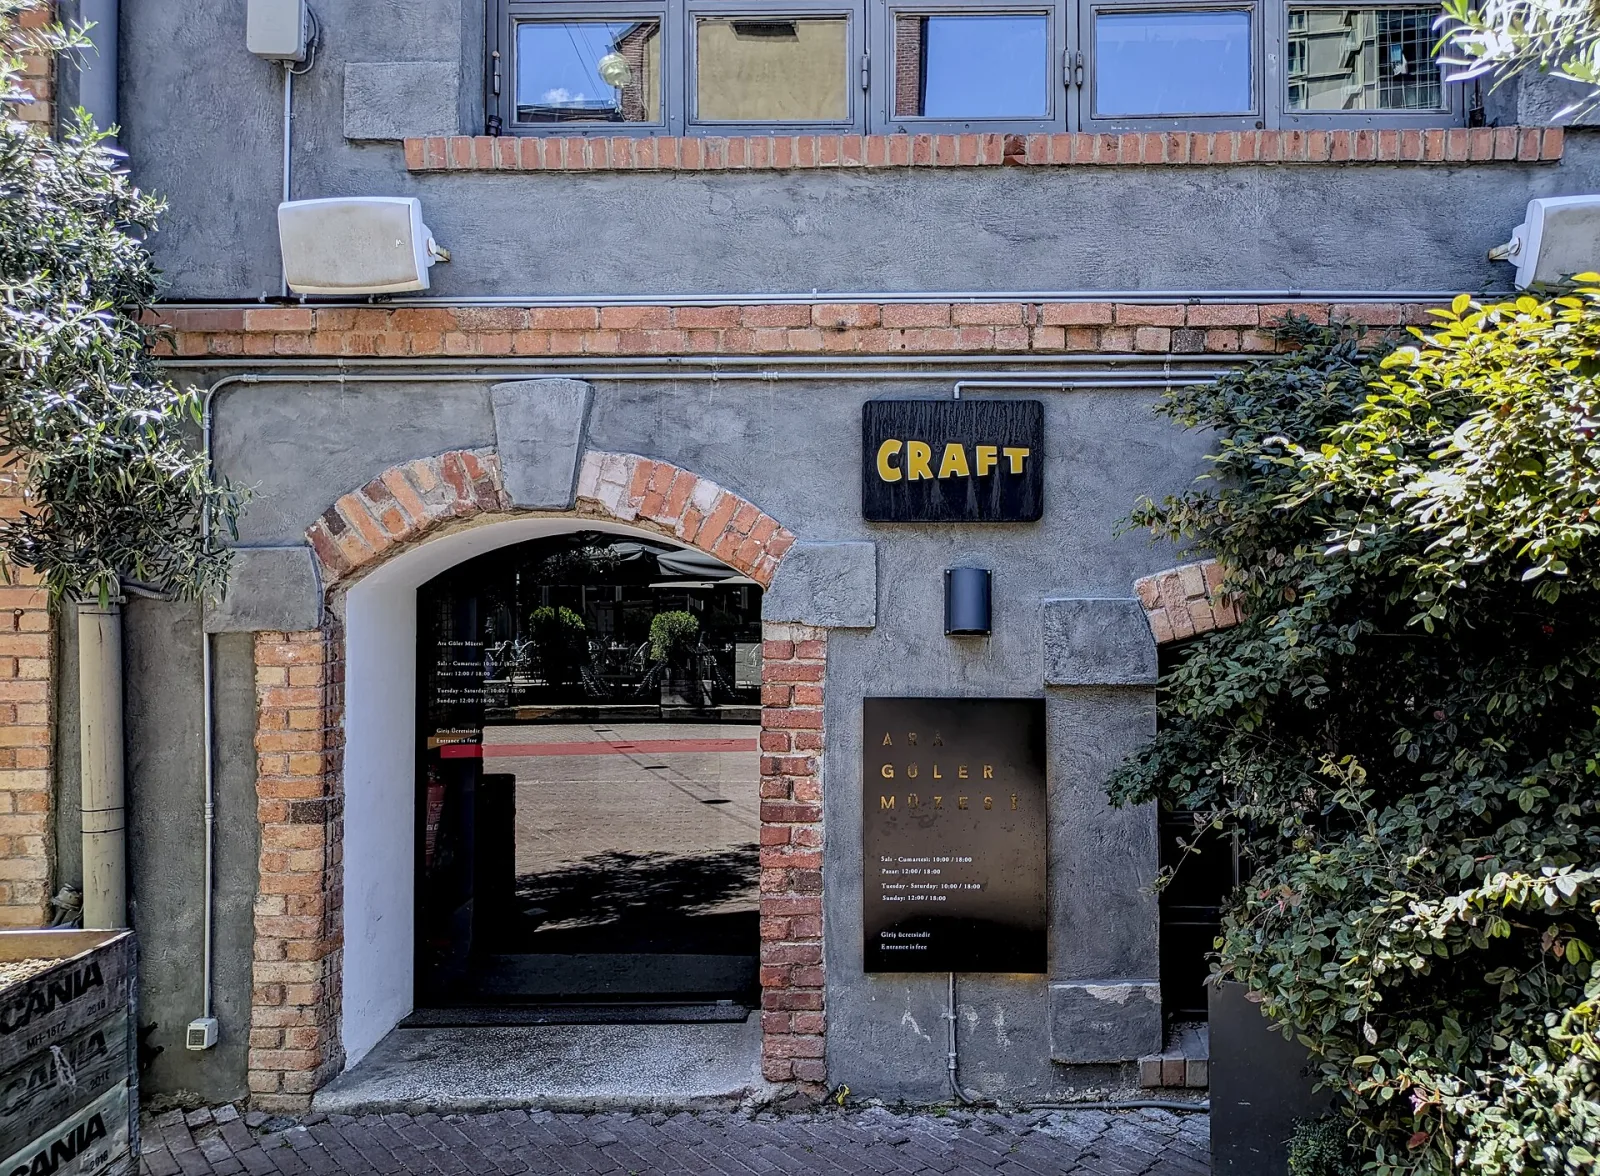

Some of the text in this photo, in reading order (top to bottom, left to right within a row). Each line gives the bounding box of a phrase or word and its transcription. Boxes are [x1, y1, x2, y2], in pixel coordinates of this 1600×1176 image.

[876, 438, 1031, 483] CRAFT
[882, 730, 943, 746] ARA
[881, 761, 993, 779] GÜLER
[880, 793, 1018, 810] MÜZESİ
[27, 1021, 66, 1048] MH-1872
